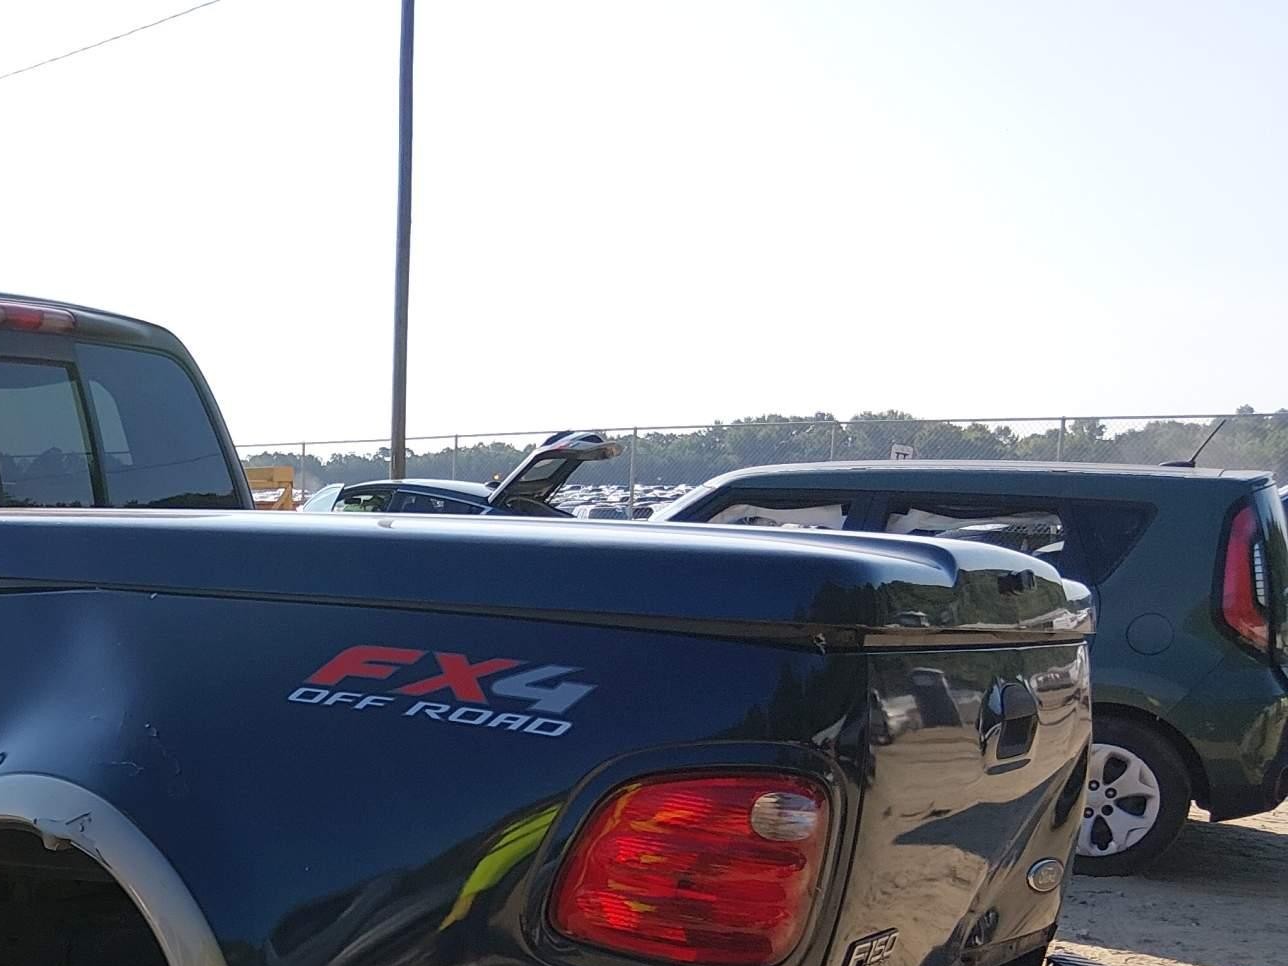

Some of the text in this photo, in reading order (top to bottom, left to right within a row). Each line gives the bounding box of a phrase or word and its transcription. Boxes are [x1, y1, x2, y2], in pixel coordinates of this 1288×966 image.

[302, 644, 600, 715] FX4
[287, 686, 573, 737] OFF ROAD
